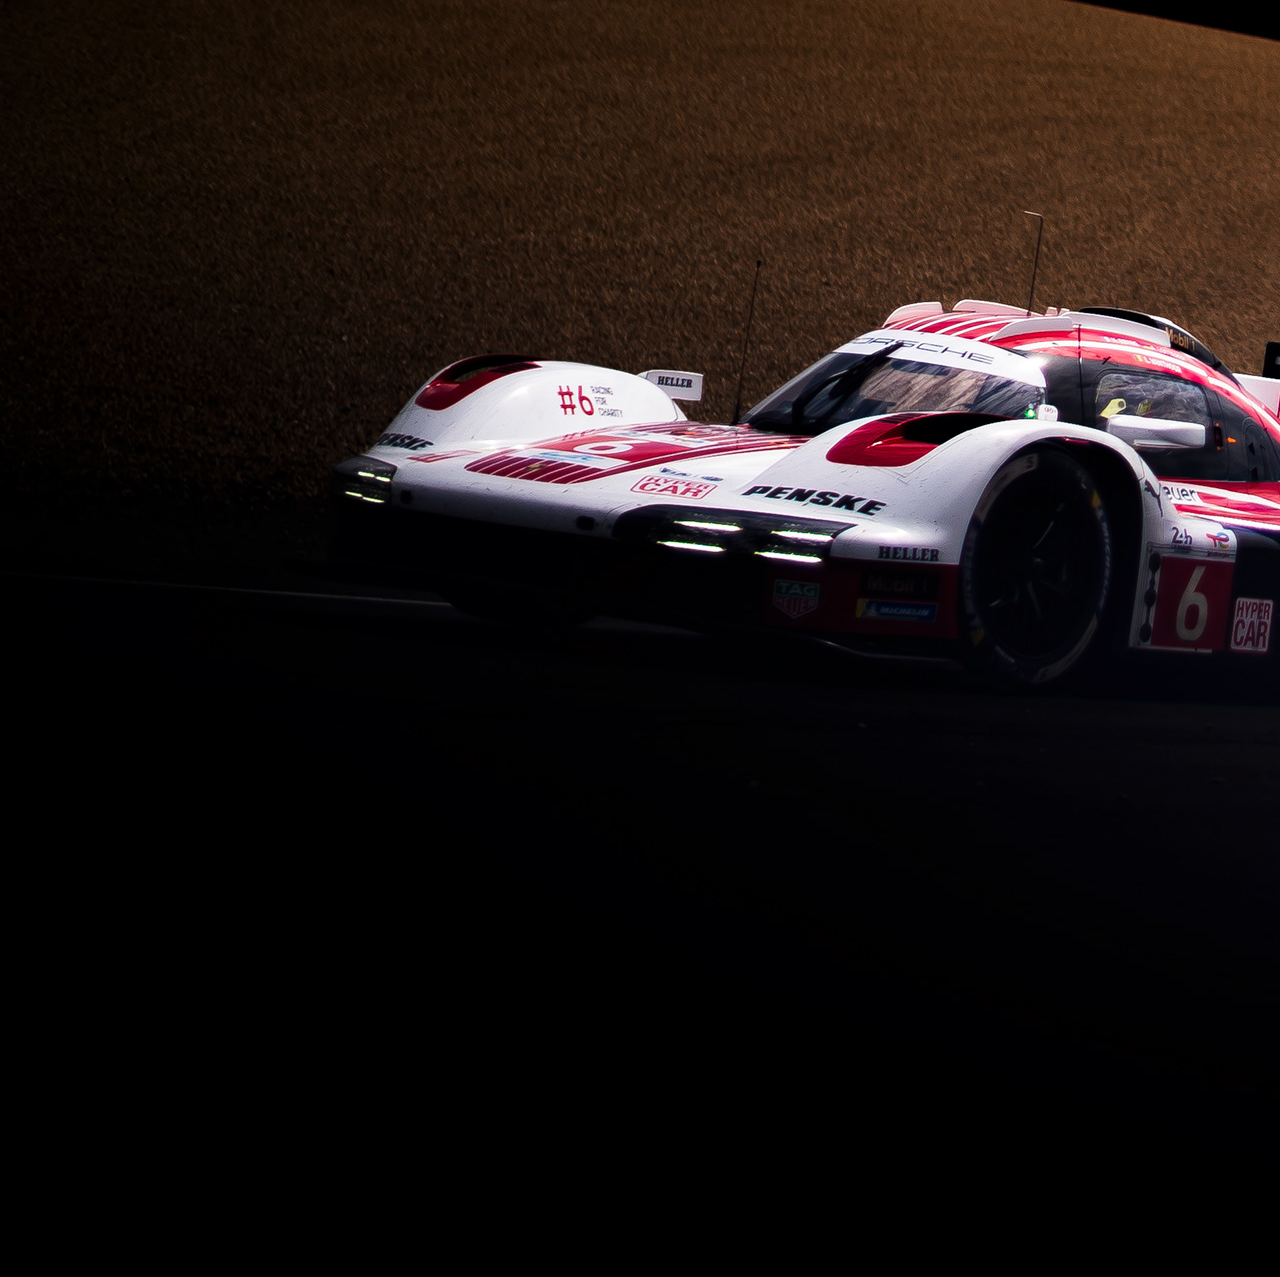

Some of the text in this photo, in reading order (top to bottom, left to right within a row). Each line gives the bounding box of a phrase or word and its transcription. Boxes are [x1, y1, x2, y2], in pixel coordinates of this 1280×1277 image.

[656, 375, 694, 389] HELLER
[557, 385, 595, 416] #6
[639, 482, 703, 497] CAR
[646, 477, 711, 490] HYPER
[741, 485, 888, 517] PENSKE
[878, 545, 940, 562] HELLER
[779, 582, 817, 597] TAG
[866, 575, 915, 593] Mobil
[774, 596, 819, 616] HEUER
[879, 606, 930, 617] MICHELIN
[1175, 565, 1209, 642] 6
[1236, 600, 1271, 620] HYPER
[1233, 619, 1269, 648] CAR
